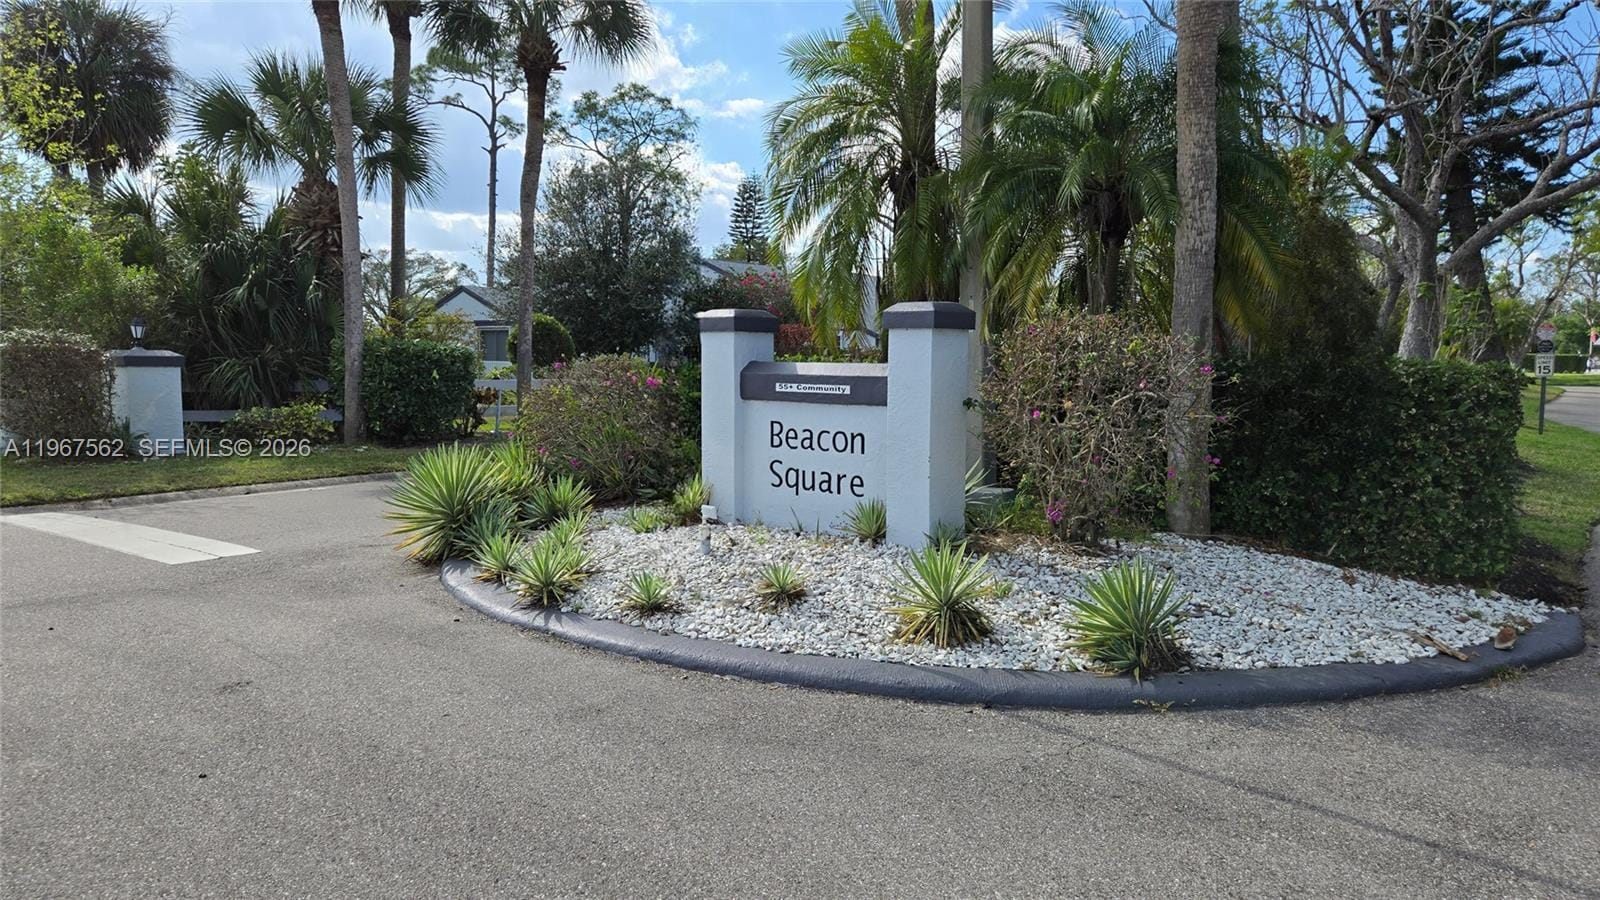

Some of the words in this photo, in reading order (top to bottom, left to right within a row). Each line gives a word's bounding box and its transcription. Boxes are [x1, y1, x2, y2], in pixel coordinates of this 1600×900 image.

[1537, 365, 1551, 375] 15
[796, 384, 847, 393] Community
[770, 420, 866, 455] Beacon
[769, 459, 865, 497] Square
